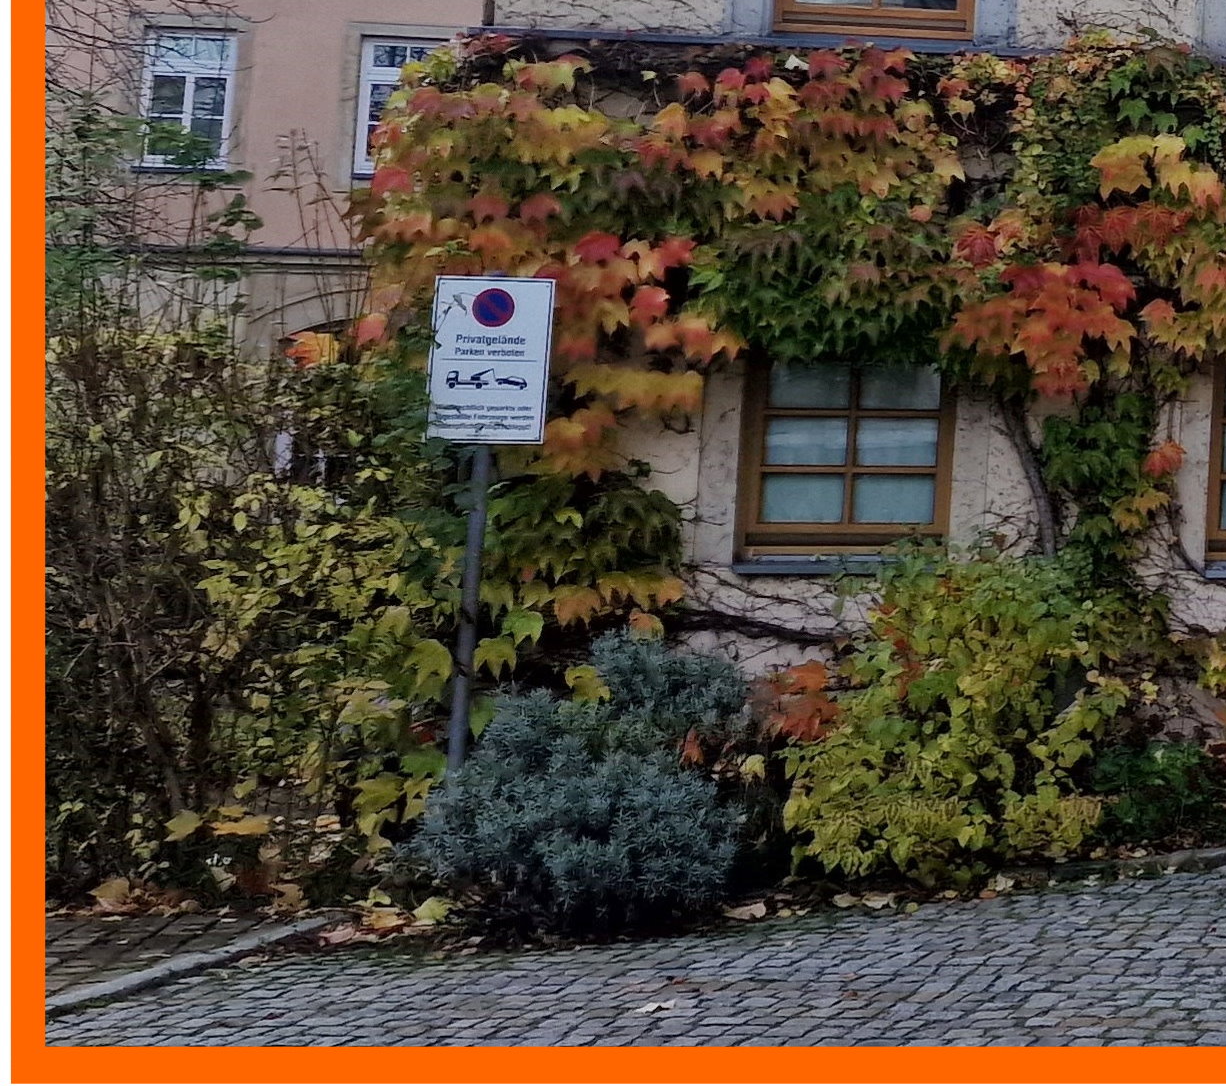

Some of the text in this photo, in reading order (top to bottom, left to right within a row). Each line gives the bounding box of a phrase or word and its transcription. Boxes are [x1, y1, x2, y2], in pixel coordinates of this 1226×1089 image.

[455, 334, 526, 347] Privatgelände
[454, 347, 525, 357] Parken verboten
